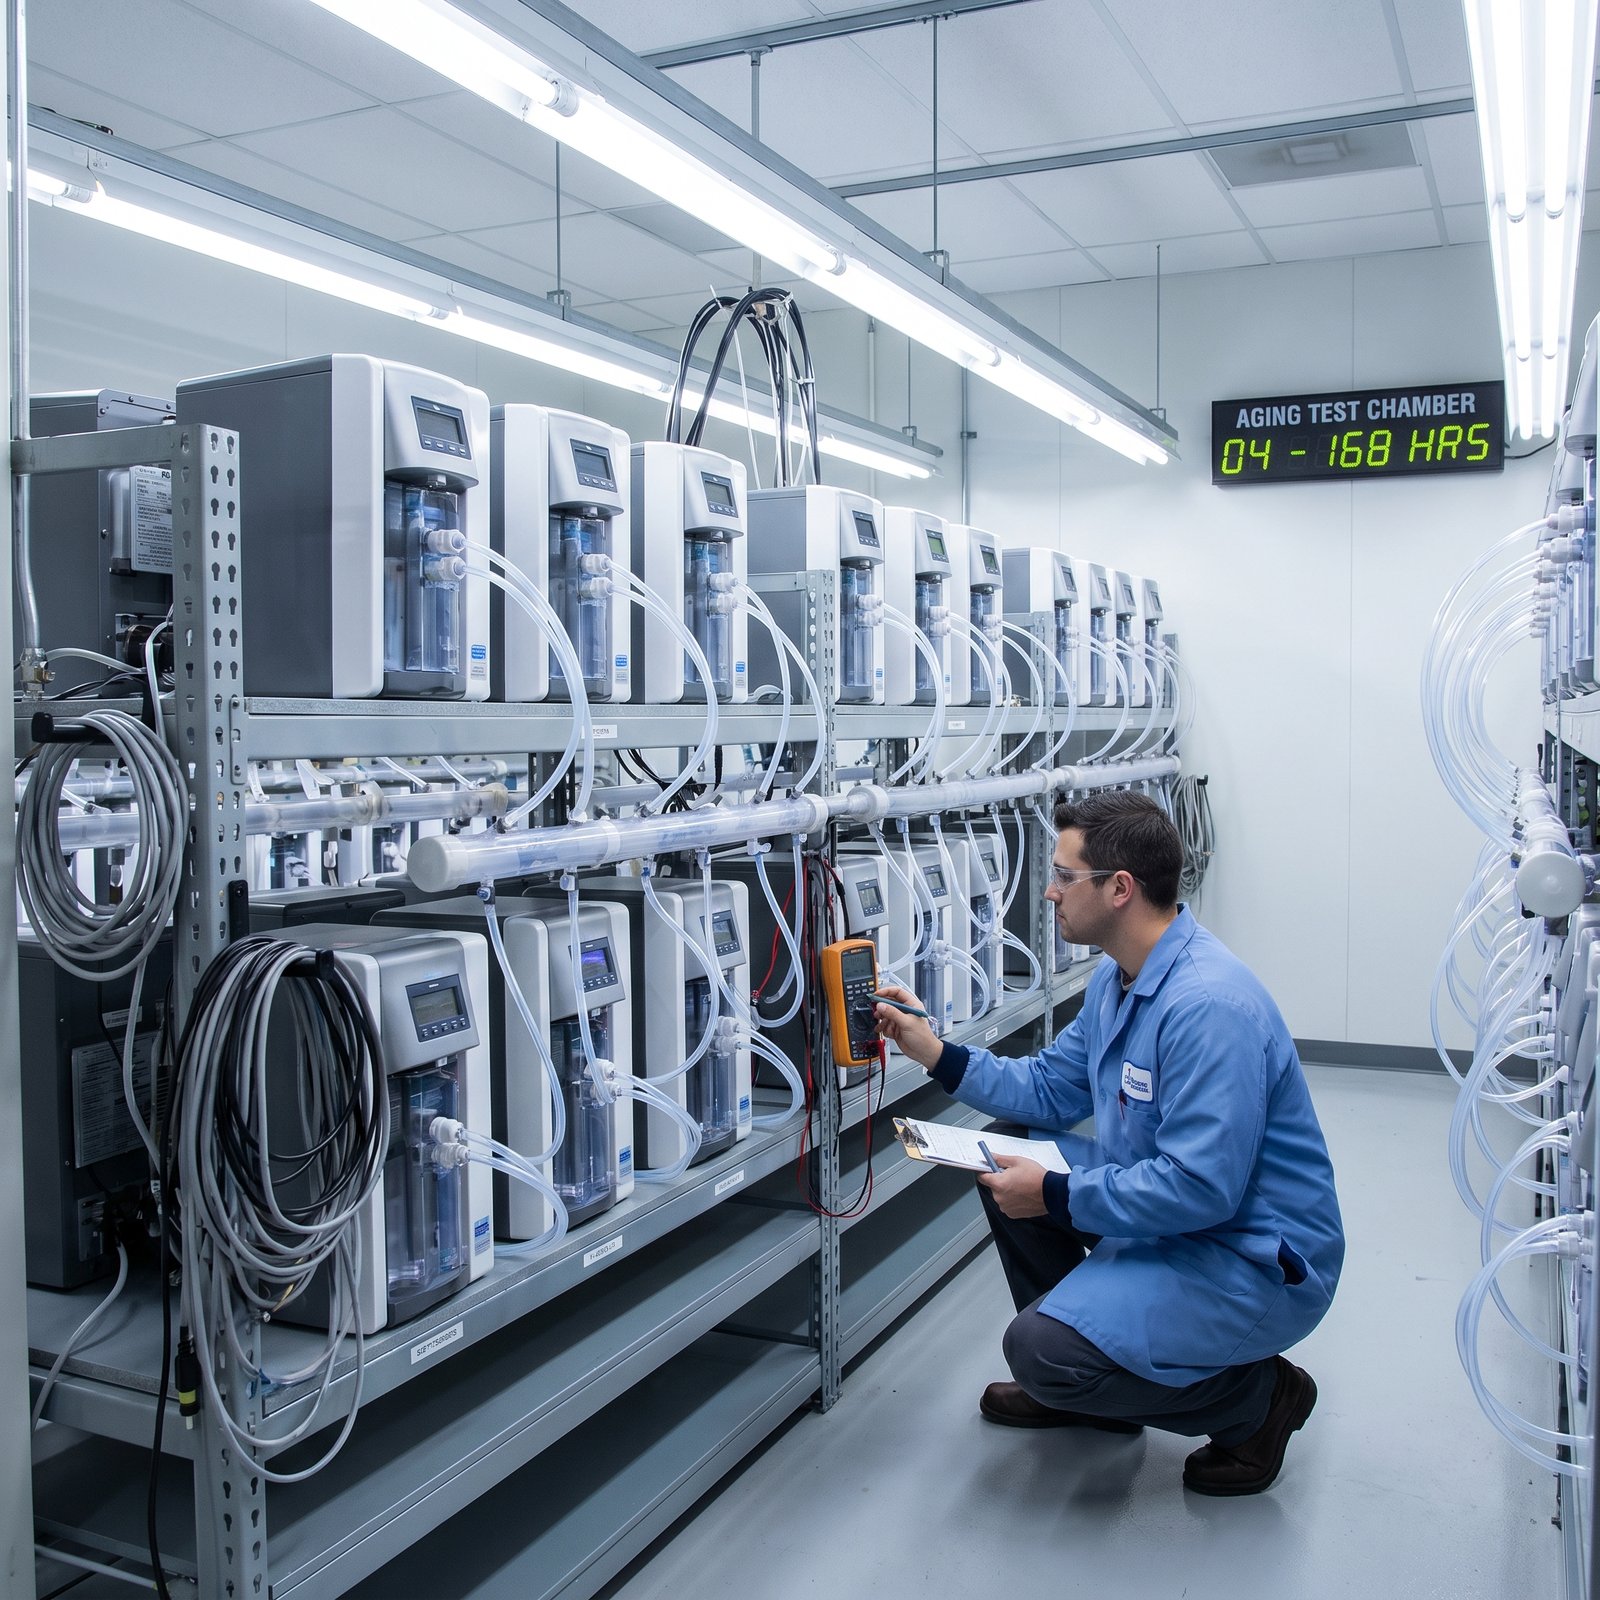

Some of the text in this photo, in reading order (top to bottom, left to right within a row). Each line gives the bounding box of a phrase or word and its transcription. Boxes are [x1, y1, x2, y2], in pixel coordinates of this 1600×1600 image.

[1236, 392, 1476, 428] AGING TEST CHAMBER
[1221, 438, 1272, 474] 04
[1328, 430, 1392, 468] 168
[1408, 423, 1490, 462] HRS
